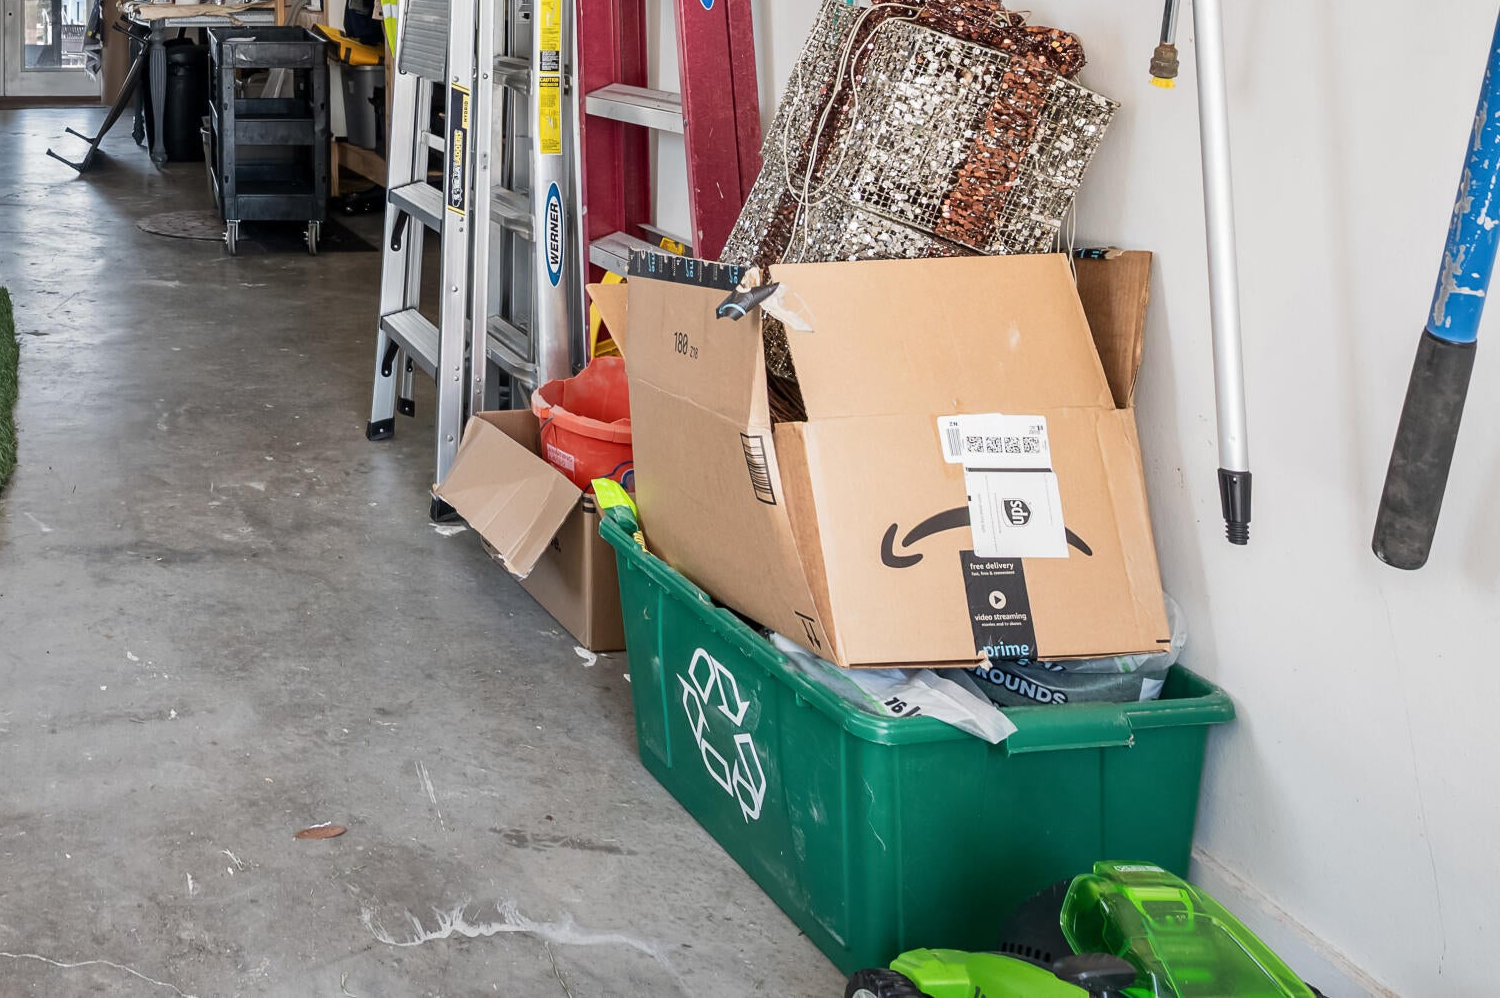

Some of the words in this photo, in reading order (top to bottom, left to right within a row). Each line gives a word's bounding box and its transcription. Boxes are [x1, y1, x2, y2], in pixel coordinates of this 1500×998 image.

[550, 202, 559, 265] WERNER
[1009, 500, 1029, 525] ups
[970, 562, 984, 570] free
[986, 562, 1014, 570] delivery
[974, 613, 993, 621] video
[993, 612, 1027, 621] streaming
[983, 641, 1030, 658] prime
[968, 666, 1069, 705] ROUNDS
